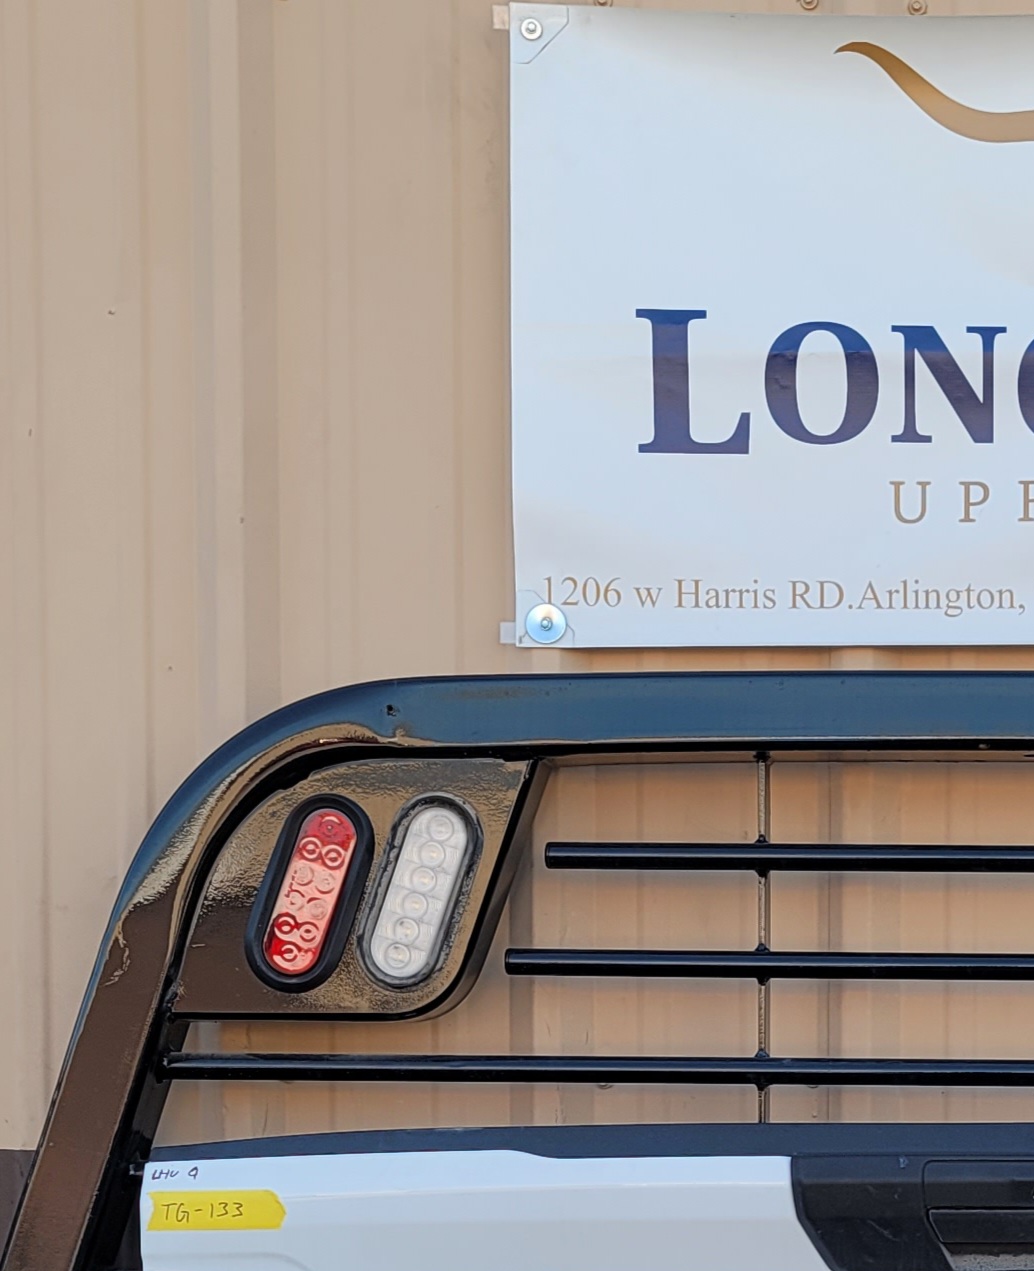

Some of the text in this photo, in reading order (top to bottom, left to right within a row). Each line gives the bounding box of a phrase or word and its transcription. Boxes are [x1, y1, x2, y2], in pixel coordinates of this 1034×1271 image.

[543, 576, 622, 607] 1206
[633, 586, 663, 608] w
[673, 578, 777, 610] Harris
[161, 1202, 244, 1223] TG-133
